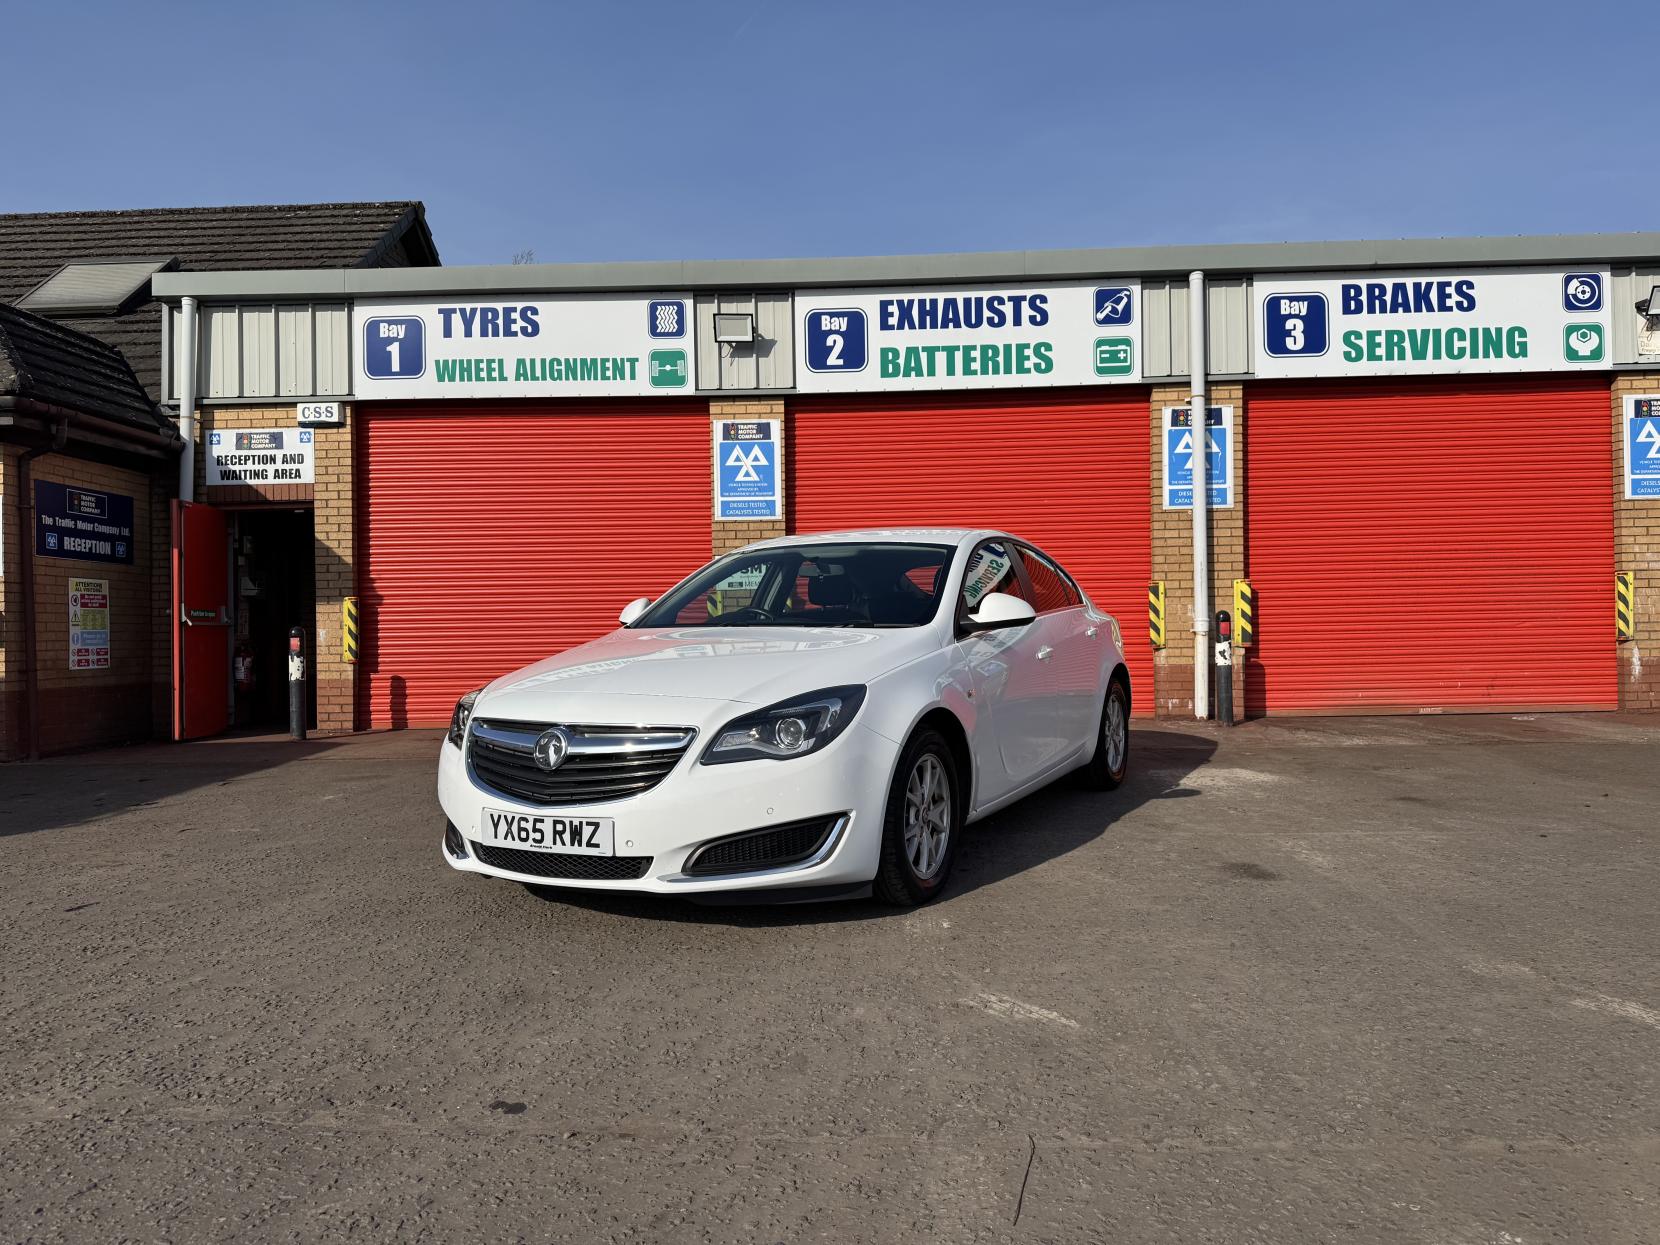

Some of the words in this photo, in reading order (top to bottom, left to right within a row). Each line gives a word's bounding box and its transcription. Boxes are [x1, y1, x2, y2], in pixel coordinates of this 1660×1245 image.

[879, 294, 1049, 331] EXHAUSTS
[1280, 299, 1308, 316] Bay
[1341, 280, 1477, 315] BRAKES
[379, 322, 406, 338] Bay
[437, 305, 540, 338] TYRES
[821, 315, 848, 331] Bay
[1285, 318, 1305, 351] 3
[386, 341, 400, 372] 1
[825, 334, 844, 366] 2
[880, 341, 1054, 378] BATTERIES
[1342, 326, 1528, 362] SERVICING
[434, 358, 508, 382] WHEEL
[515, 357, 640, 381] ALIGNMENT
[216, 454, 277, 466] RECEPTION
[281, 453, 305, 465] AND
[220, 469, 268, 481] WAITING
[273, 468, 302, 480] AREA
[41, 515, 54, 525] The
[55, 516, 76, 528] Traffic
[76, 520, 94, 531] Motor
[94, 523, 120, 535] Company
[63, 536, 112, 555] RECEPTION
[490, 813, 545, 844] YX65
[552, 819, 601, 848] RWZ
